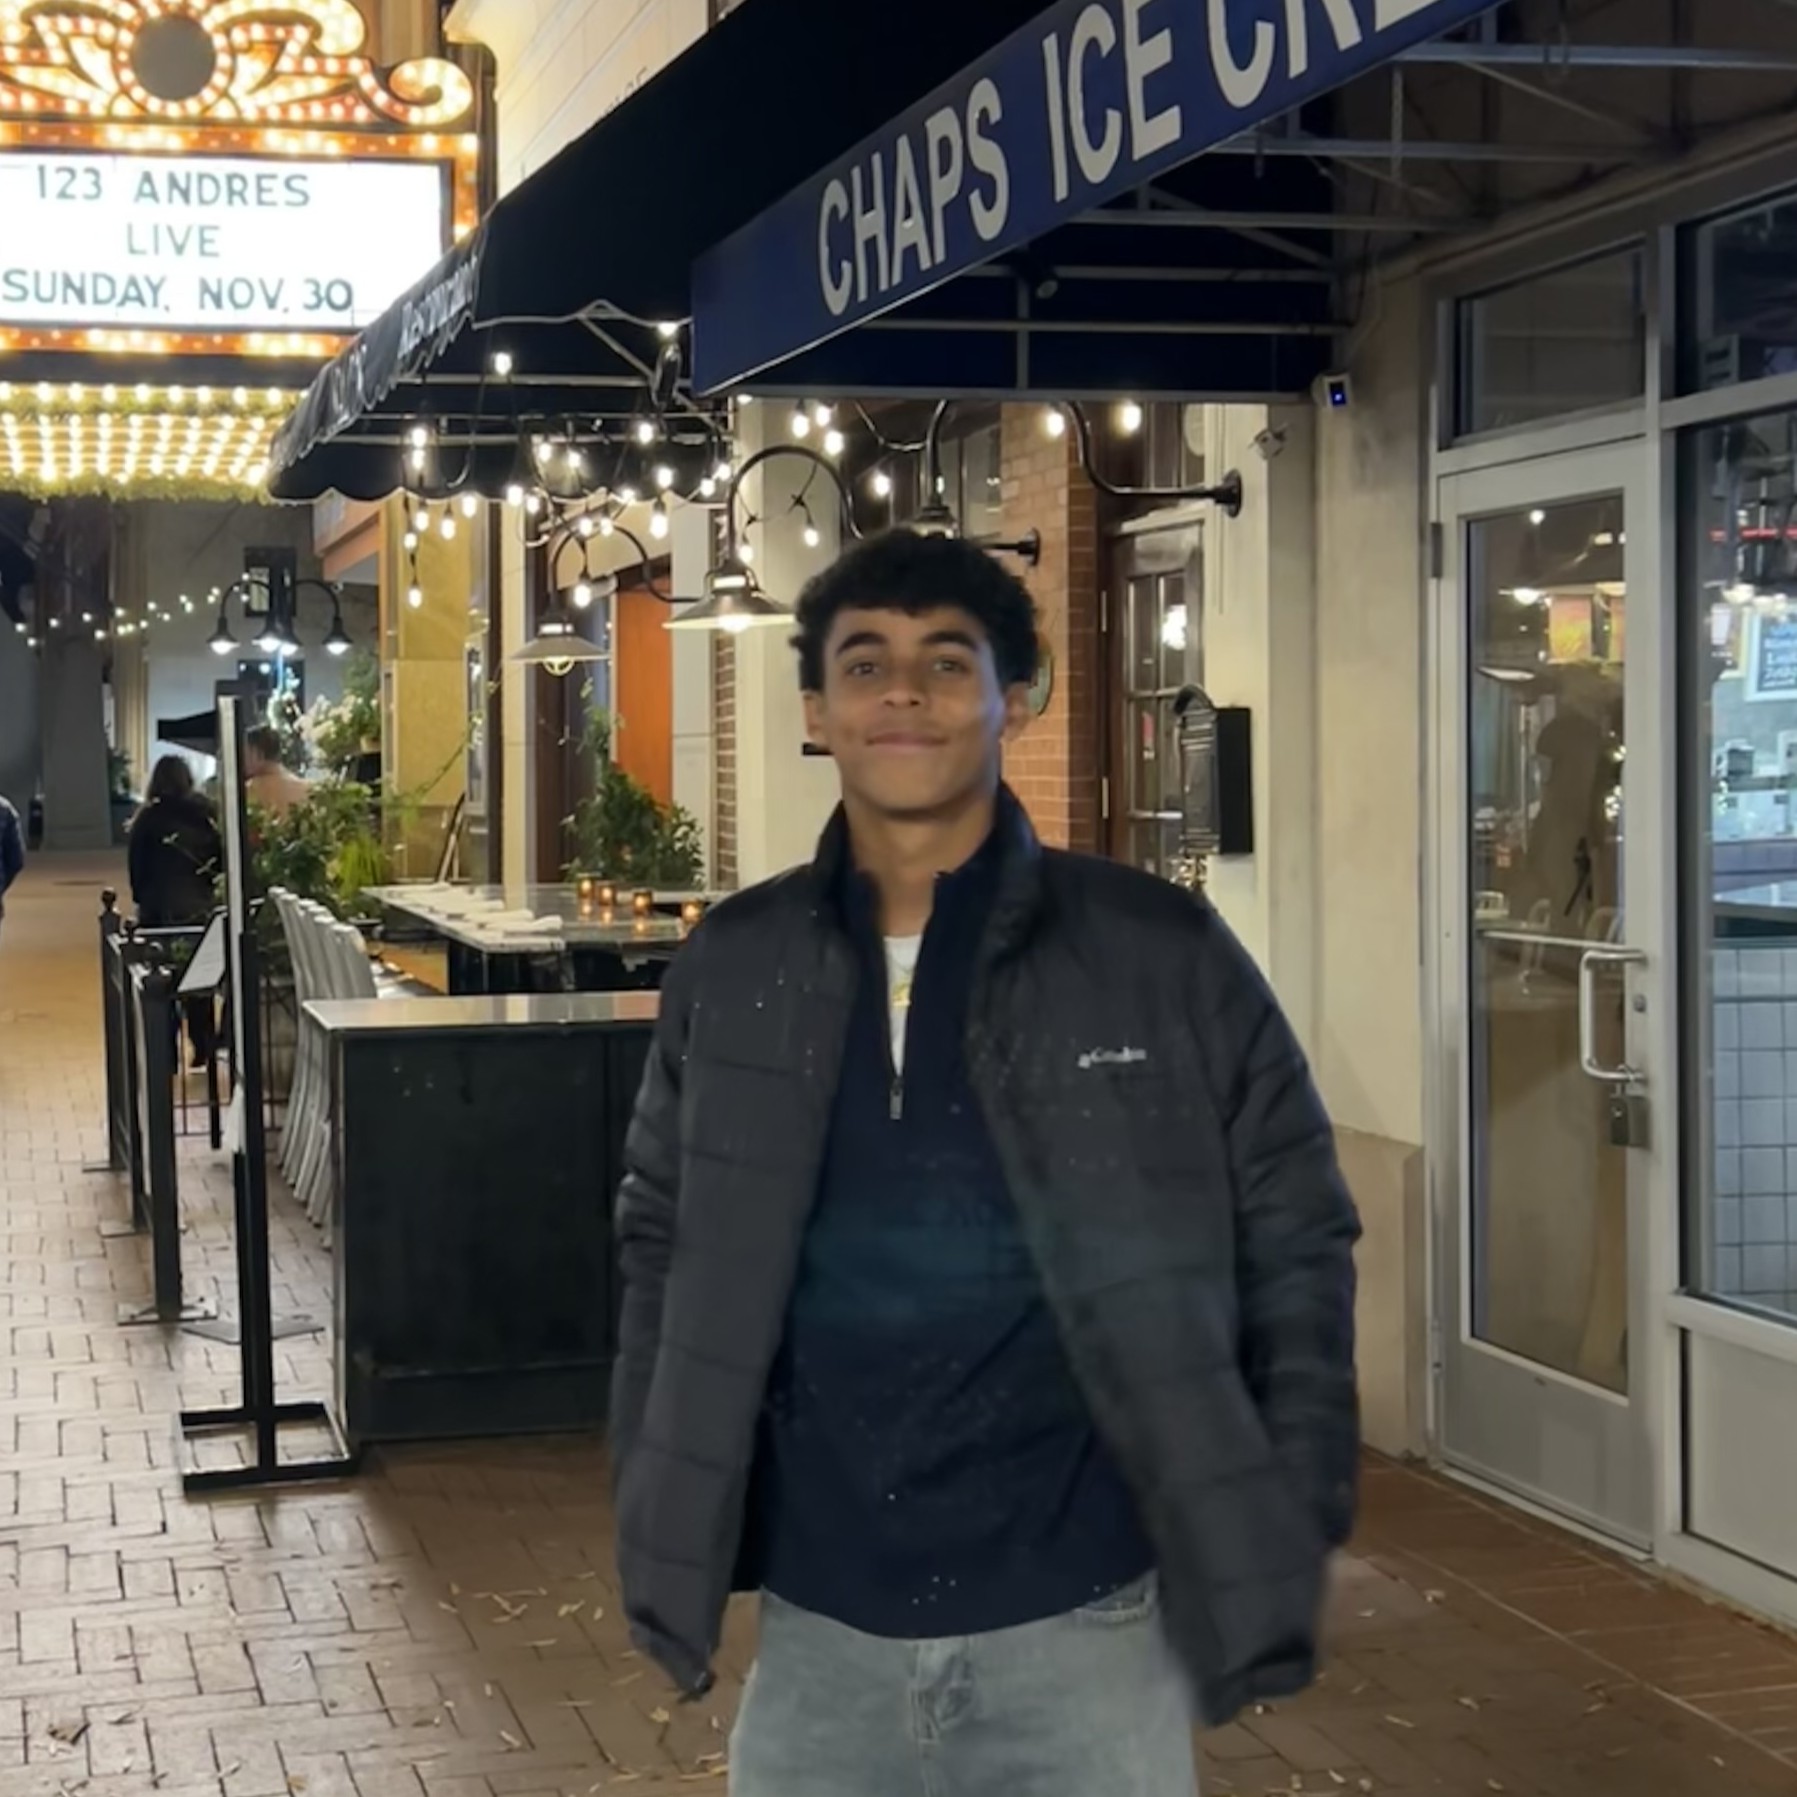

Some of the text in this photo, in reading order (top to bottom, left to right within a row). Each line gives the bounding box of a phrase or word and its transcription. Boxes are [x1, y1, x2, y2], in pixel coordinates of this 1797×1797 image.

[818, 78, 1009, 316] CHAPS
[1042, 0, 1182, 202] ICE
[37, 164, 311, 207] 123 ANDRES
[127, 223, 221, 257] LIVE
[303, 278, 353, 312] 30
